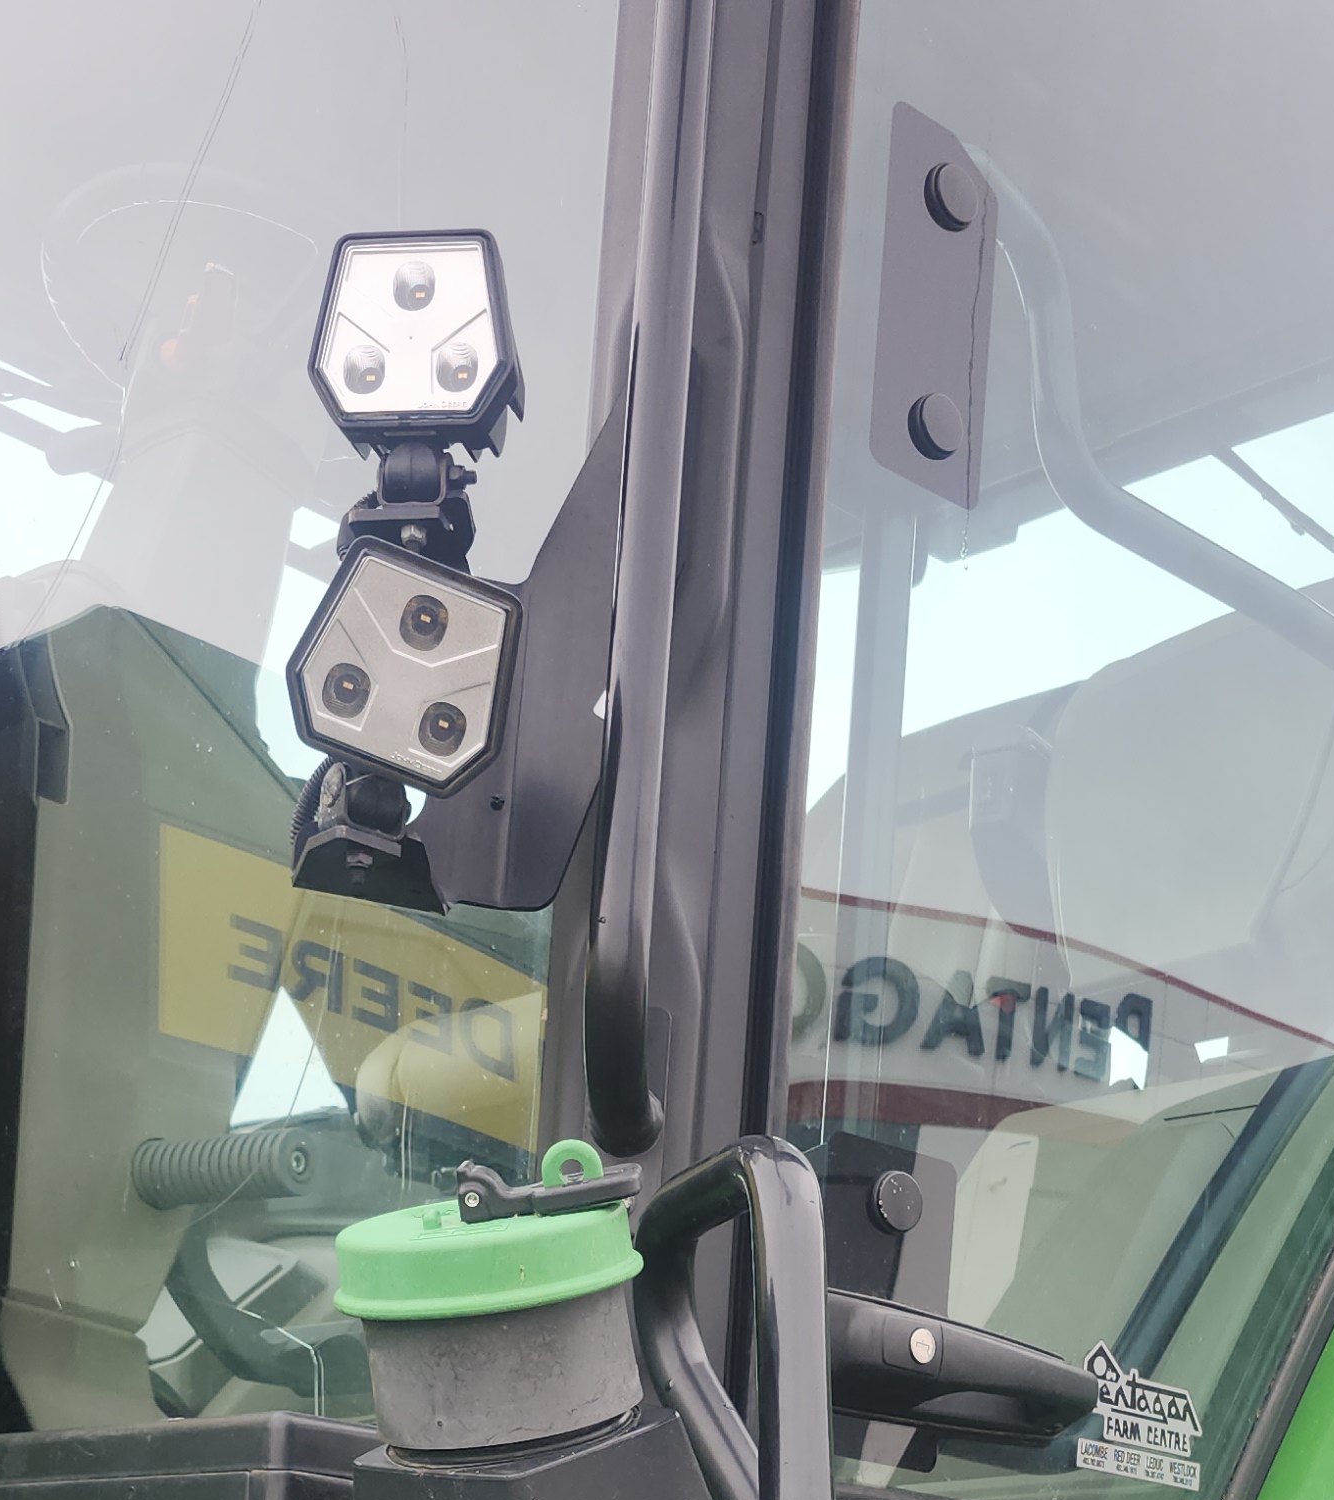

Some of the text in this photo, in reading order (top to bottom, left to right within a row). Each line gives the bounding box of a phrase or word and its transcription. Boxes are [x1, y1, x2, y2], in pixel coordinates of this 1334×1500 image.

[1106, 1416, 1189, 1452] FARM CENTRE
[1146, 1455, 1164, 1472] LEDUC
